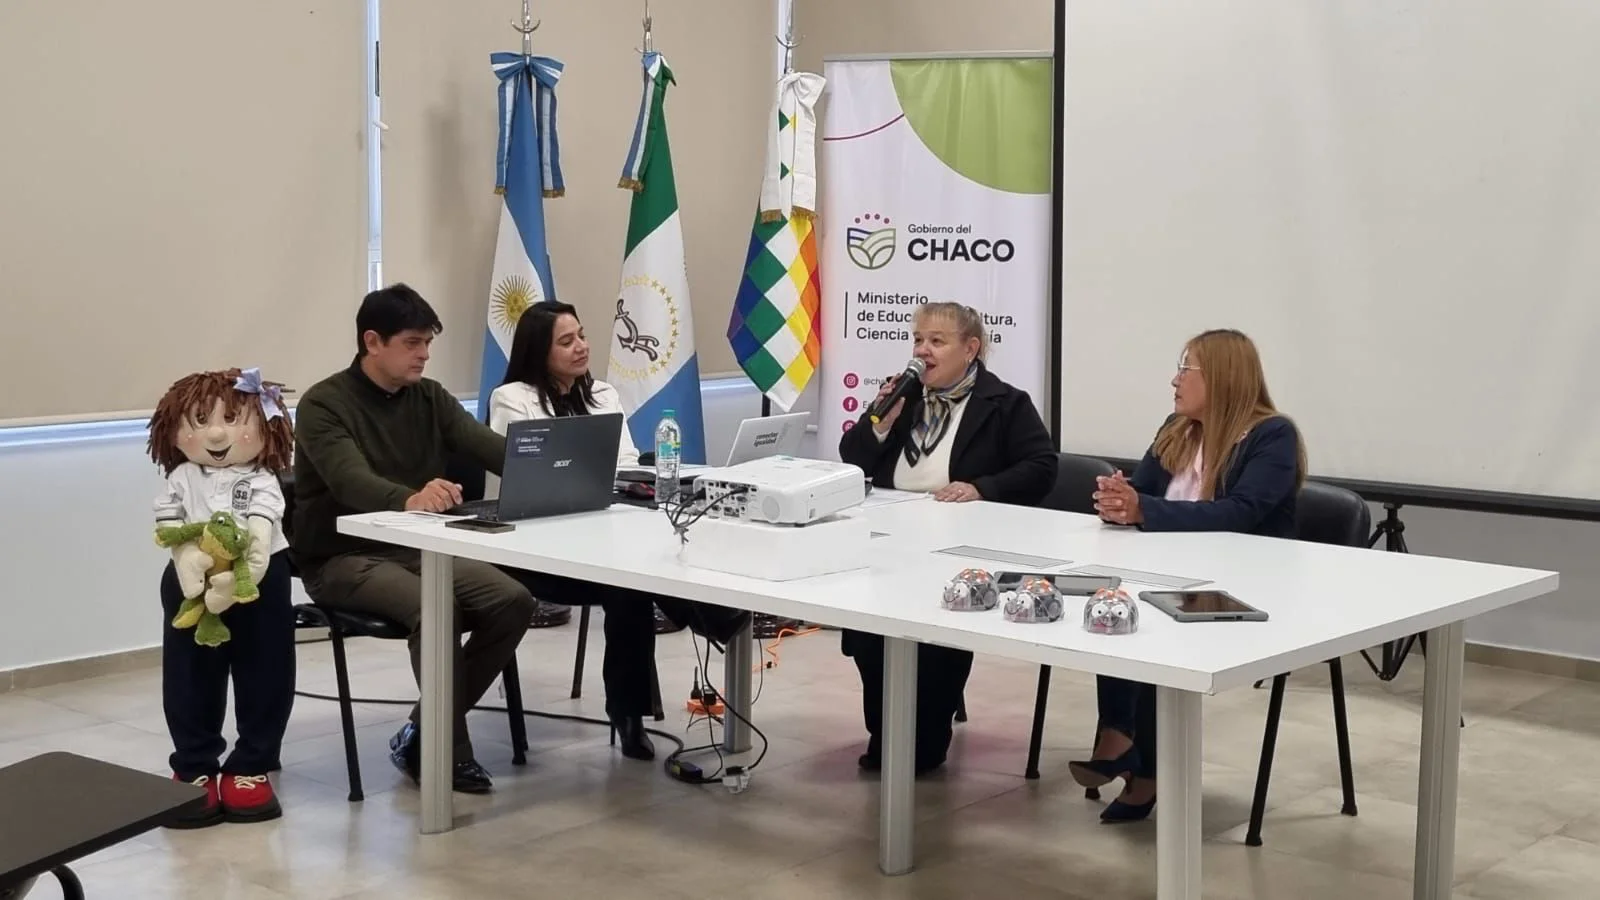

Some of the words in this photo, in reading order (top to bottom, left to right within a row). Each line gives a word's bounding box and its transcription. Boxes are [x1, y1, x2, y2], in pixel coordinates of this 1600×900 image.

[908, 223, 954, 234] Gobierno
[956, 224, 972, 234] del
[907, 238, 1015, 262] CHACO
[857, 291, 929, 305] Ministerio
[857, 309, 875, 322] de
[856, 327, 909, 341] Ciencia
[553, 459, 572, 468] acer
